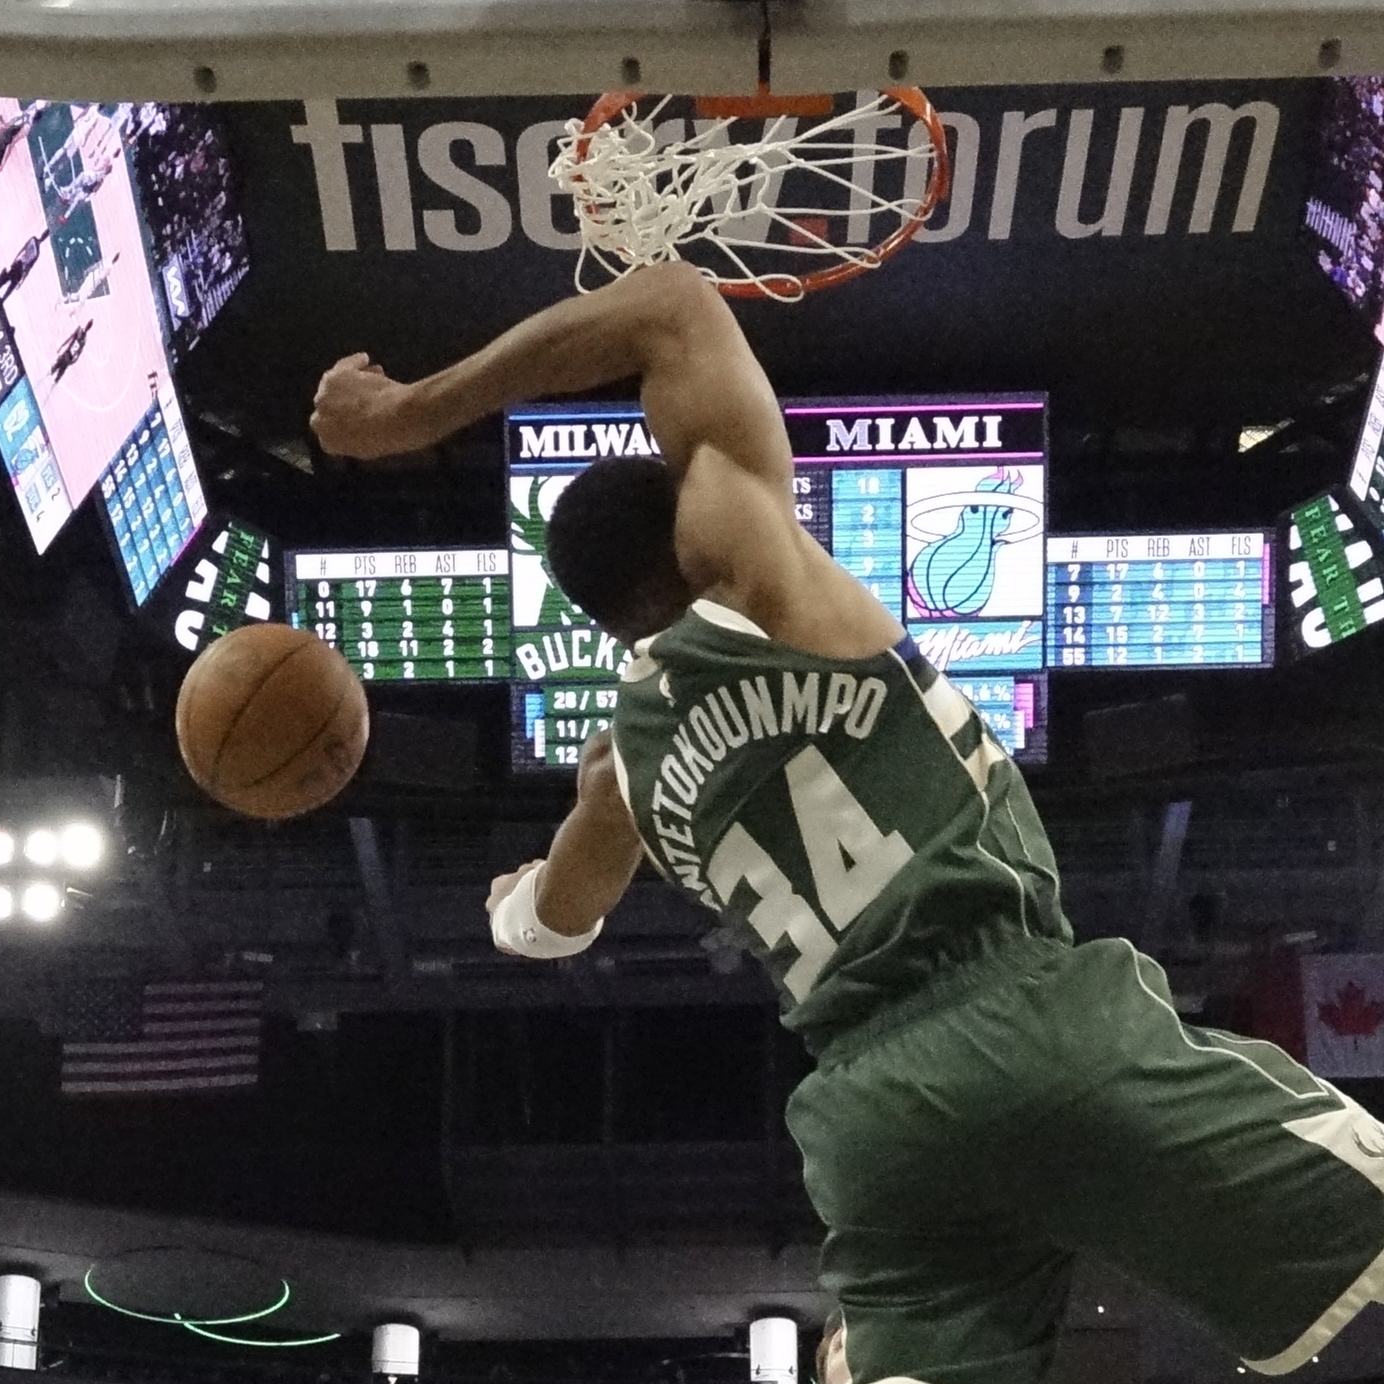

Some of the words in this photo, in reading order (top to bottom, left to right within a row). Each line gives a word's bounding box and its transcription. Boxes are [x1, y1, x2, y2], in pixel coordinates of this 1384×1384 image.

[519, 423, 661, 458] MILWA
[826, 416, 1003, 451] MIAMI
[862, 504, 875, 523] 2
[1107, 539, 1128, 558] PTS
[1148, 538, 1170, 557] REB
[1189, 537, 1210, 556] AST
[1232, 536, 1250, 555] FLS
[1304, 507, 1338, 585] FEAR
[355, 556, 375, 574] PTS
[395, 555, 416, 573] REB
[436, 554, 456, 572] AST
[478, 553, 496, 572] FLS
[1068, 564, 1080, 581] 7
[1107, 564, 1128, 580] 17
[1153, 563, 1164, 579] 6
[1194, 562, 1204, 578] 0
[1236, 561, 1244, 577] 1
[318, 582, 329, 597] 0
[356, 580, 376, 597] 17
[401, 580, 411, 596] 6
[441, 578, 452, 595] 7
[483, 578, 491, 593] 1
[1069, 586, 1080, 602] 9
[1112, 585, 1122, 601] 2
[1153, 584, 1164, 600] 4
[1194, 583, 1204, 599] 0
[1234, 583, 1245, 598] 4
[316, 602, 334, 617] 11
[361, 601, 372, 616] 9
[404, 600, 411, 615] 1
[442, 599, 453, 614] 0
[483, 598, 491, 614] 1
[1063, 607, 1085, 623] 13
[1110, 606, 1122, 622] 7
[1148, 605, 1170, 621] 12
[1193, 604, 1204, 620] 3
[1235, 603, 1245, 619] 2
[316, 623, 336, 639] 12
[362, 622, 372, 638] 3
[403, 622, 413, 638] 2
[442, 621, 453, 636] 4
[484, 620, 492, 635] 1
[1064, 627, 1085, 643] 14
[1106, 626, 1128, 642] 15
[1153, 625, 1164, 641] 2
[1193, 624, 1204, 640] 7
[1236, 624, 1244, 639] 1
[358, 641, 379, 657] 18
[400, 641, 418, 656] 11
[443, 639, 454, 655] 2
[483, 639, 493, 654] 2
[915, 620, 1042, 672] Miami
[1063, 649, 1085, 665] 55
[1107, 648, 1128, 664] 12
[1155, 647, 1163, 662] 1
[1193, 645, 1203, 662] 2
[1236, 645, 1244, 661] 1
[364, 663, 374, 679] 3
[404, 662, 414, 678] 2
[446, 661, 454, 677] 1
[485, 660, 493, 676] 1
[707, 744, 915, 1000] 34
